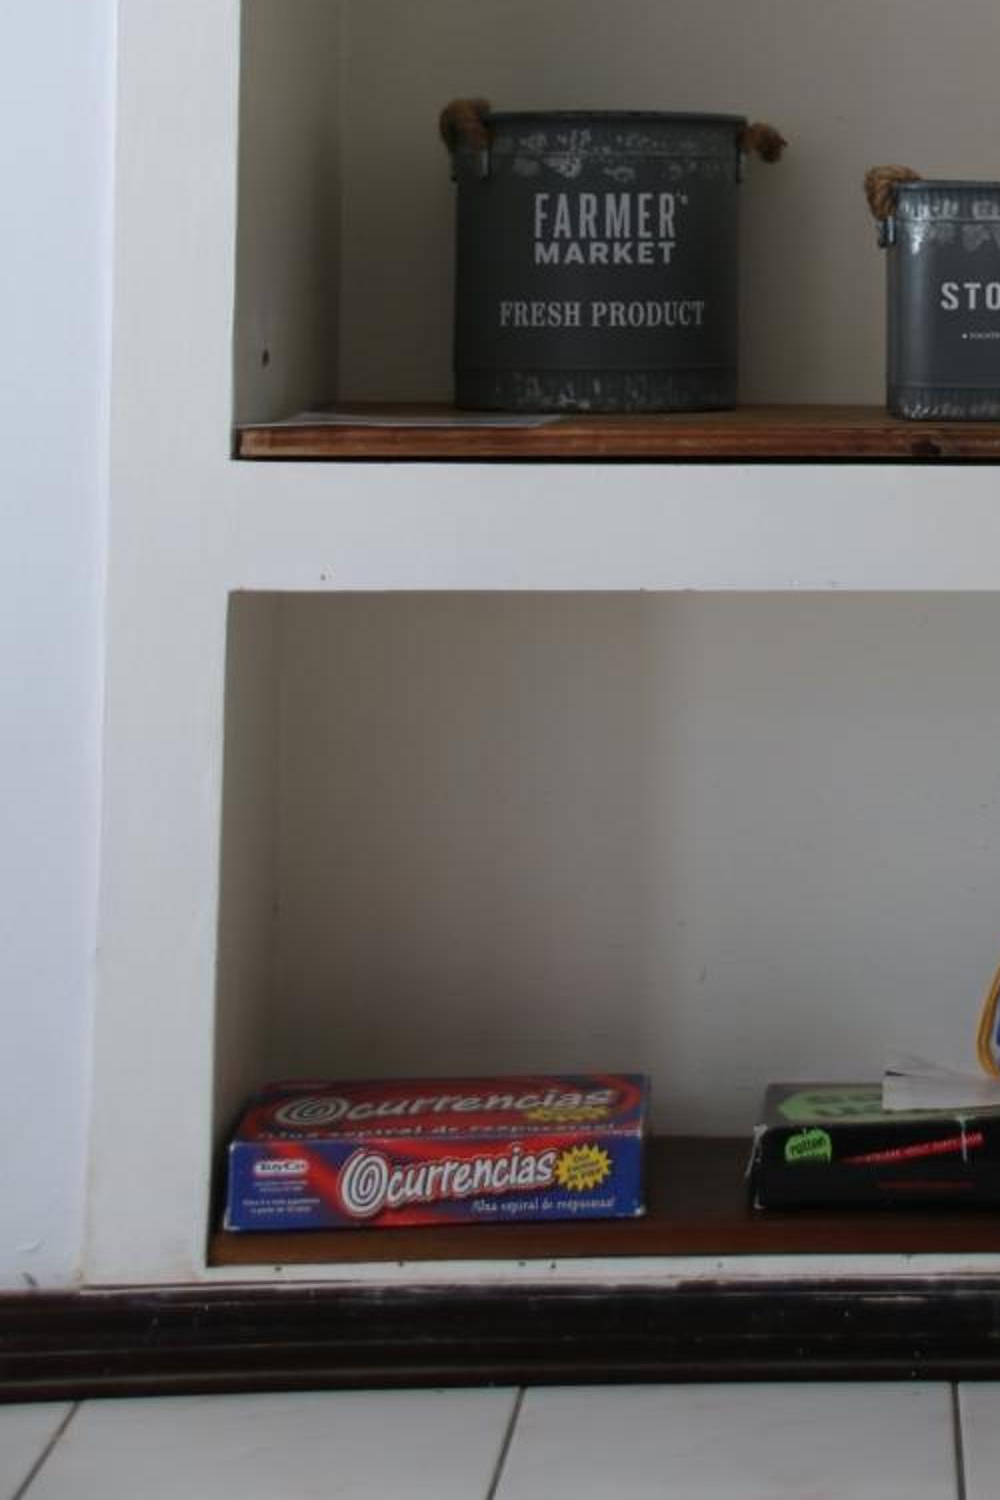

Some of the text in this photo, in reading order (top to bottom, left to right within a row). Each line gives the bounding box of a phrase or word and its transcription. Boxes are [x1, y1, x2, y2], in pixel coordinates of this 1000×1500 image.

[534, 241, 676, 265] MARKET
[499, 300, 706, 327] FRESH PRODUCT
[274, 1089, 613, 1126] Ocurrencias
[340, 1146, 557, 1218] Ocurrencias
